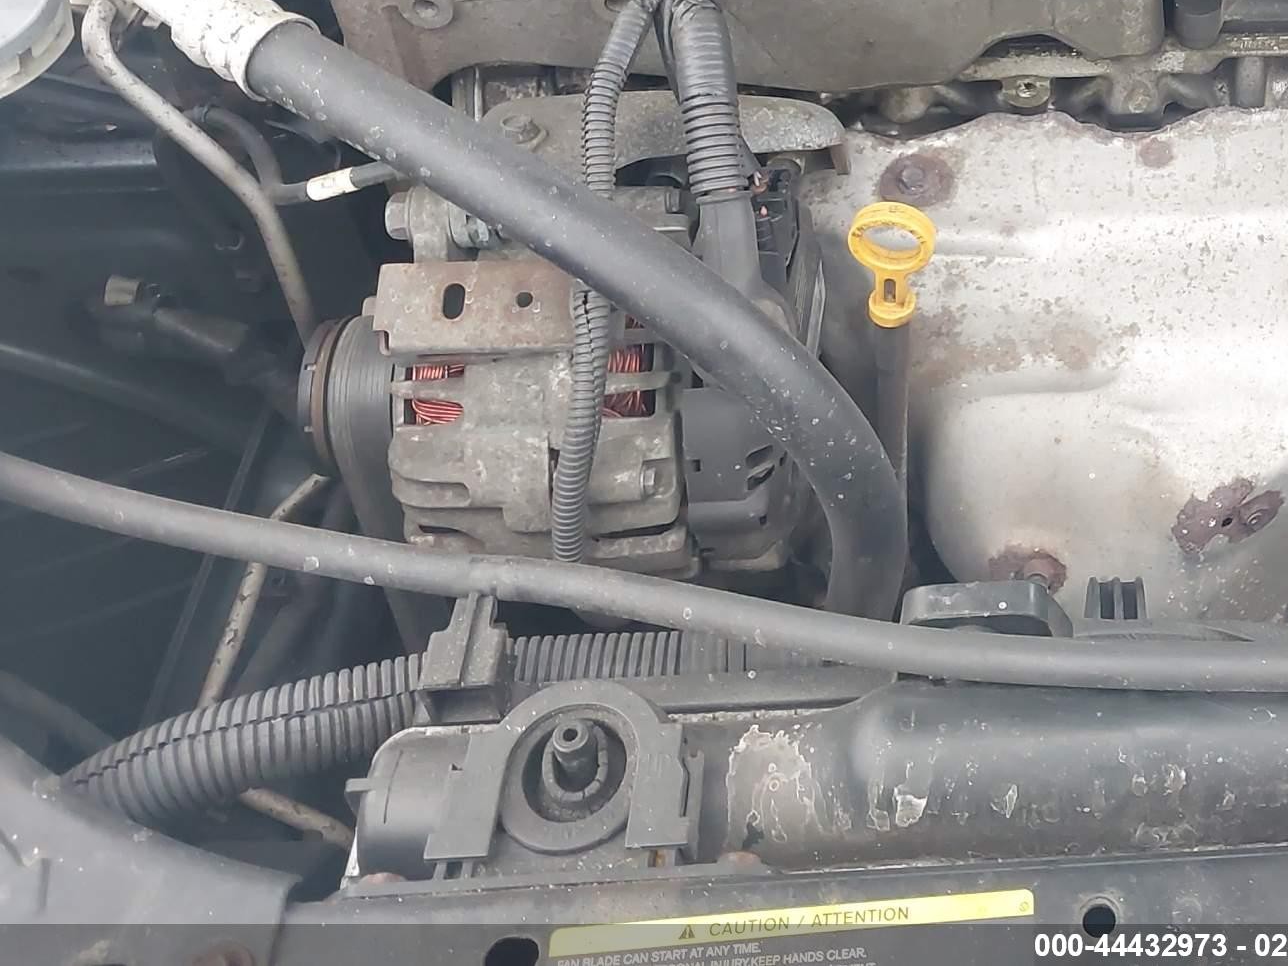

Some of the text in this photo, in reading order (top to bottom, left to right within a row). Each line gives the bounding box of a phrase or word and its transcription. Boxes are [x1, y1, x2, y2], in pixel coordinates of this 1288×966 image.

[709, 916, 790, 937] CAUTION
[811, 906, 910, 928] ATTENTION
[582, 954, 621, 966] BLADE
[623, 951, 649, 964] CAN
[651, 948, 688, 962] START
[689, 946, 705, 958] AT
[706, 944, 732, 957] ANY
[783, 949, 825, 964] HANDS
